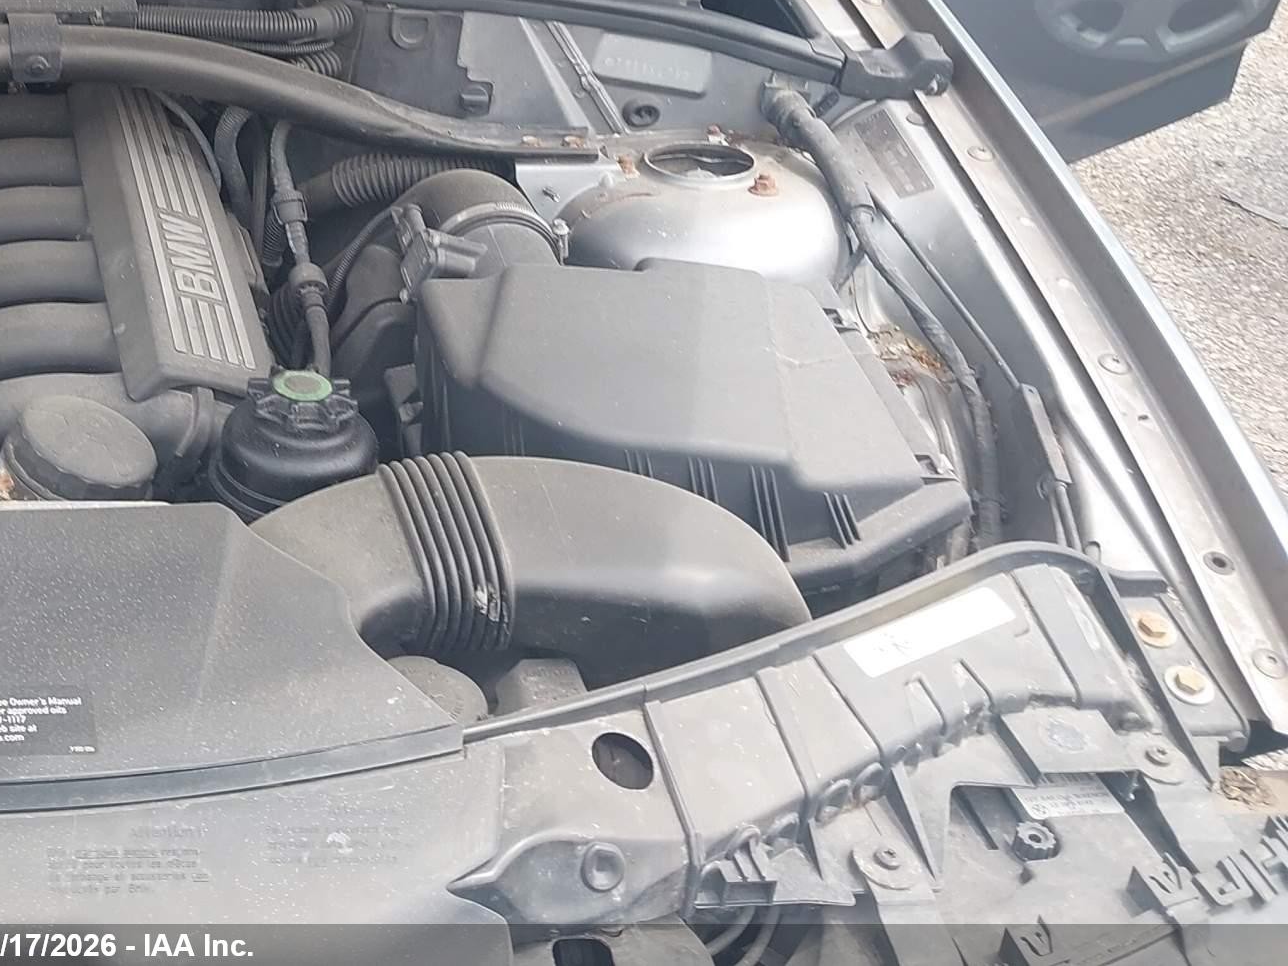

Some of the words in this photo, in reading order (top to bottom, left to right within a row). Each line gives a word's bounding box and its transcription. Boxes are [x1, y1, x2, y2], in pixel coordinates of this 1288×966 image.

[159, 212, 223, 302] BMW
[9, 697, 47, 706] Owner's
[48, 696, 82, 706] Manual
[7, 706, 49, 717] approved
